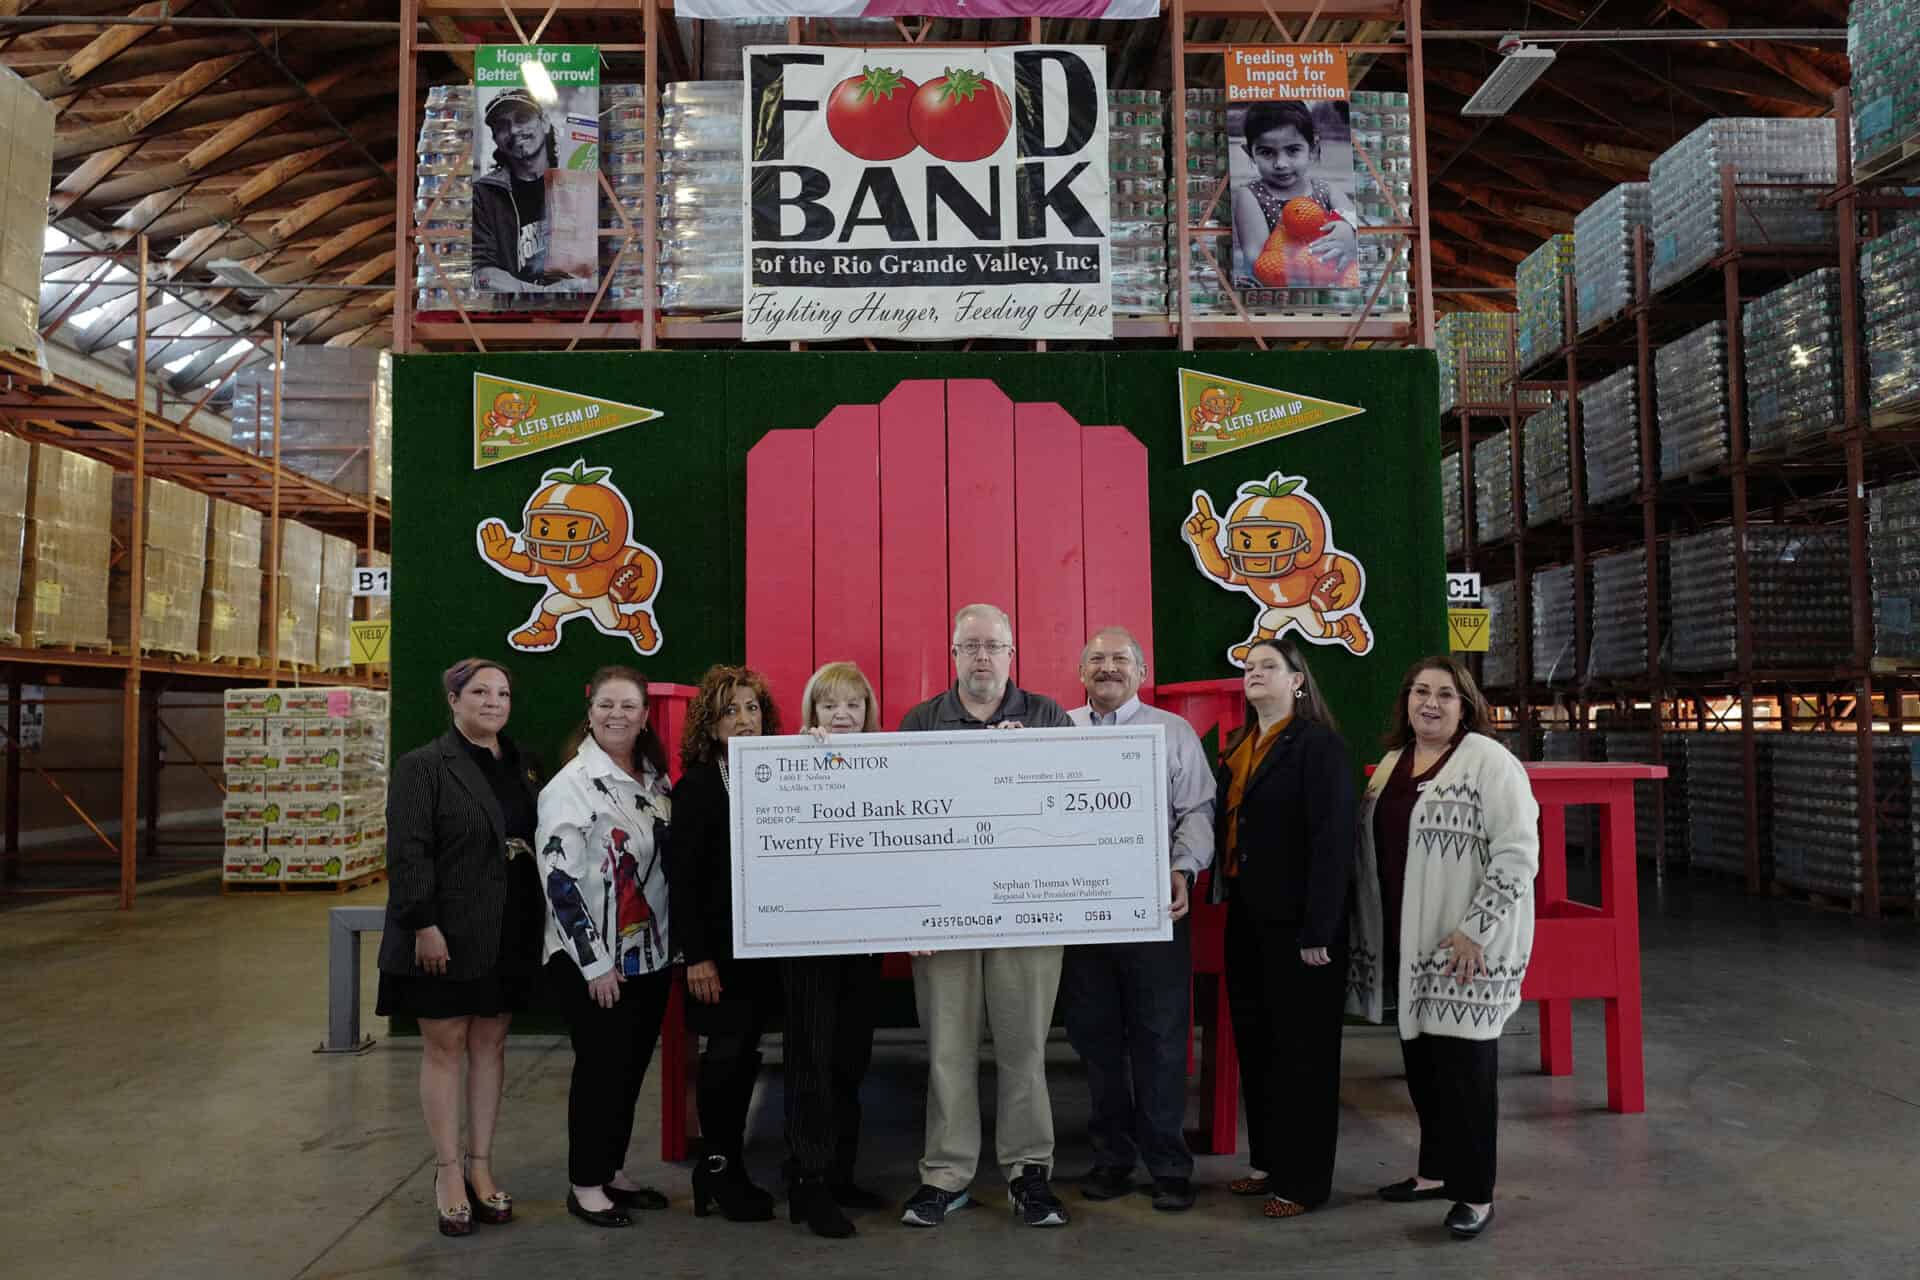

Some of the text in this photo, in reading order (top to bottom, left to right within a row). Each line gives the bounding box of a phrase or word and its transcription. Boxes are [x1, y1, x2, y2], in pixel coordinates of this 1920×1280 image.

[496, 48, 571, 65] Hope for a
[1235, 51, 1334, 67] Feeding with
[477, 66, 595, 81] Better orrow!
[1246, 67, 1326, 84] Impact for
[1229, 85, 1345, 99] Better Nutrition
[750, 160, 1106, 243] BANK
[759, 250, 1099, 276] of the Rio Grande Valley, Inc.
[747, 286, 1109, 335] Fighting Hunger, Feeding Hope
[518, 417, 548, 436] LETS
[550, 409, 583, 428] TEAM
[585, 404, 600, 420] UP
[1225, 414, 1253, 432] LETS
[1255, 406, 1287, 424] TEAM
[1288, 400, 1303, 415] UP
[358, 571, 388, 592] B1
[1447, 578, 1478, 598] C1
[1454, 617, 1480, 628] YIELD
[358, 629, 384, 641] YIELD
[776, 758, 809, 772] THE
[993, 776, 1014, 785] DATE
[756, 806, 801, 815] PAY TO THE
[812, 798, 953, 819] Food Bank RGV
[1046, 791, 1132, 814] $ 25,000
[756, 816, 796, 825] ORDER OF
[975, 821, 992, 833] 00
[760, 833, 823, 856] Twenty
[828, 832, 865, 849] Five
[869, 828, 954, 847] Thousand
[972, 834, 995, 846] 100
[1098, 836, 1135, 845] DOLLARS
[992, 876, 1110, 892] Stephan Thomas Wingert
[758, 904, 785, 913] MEMO
